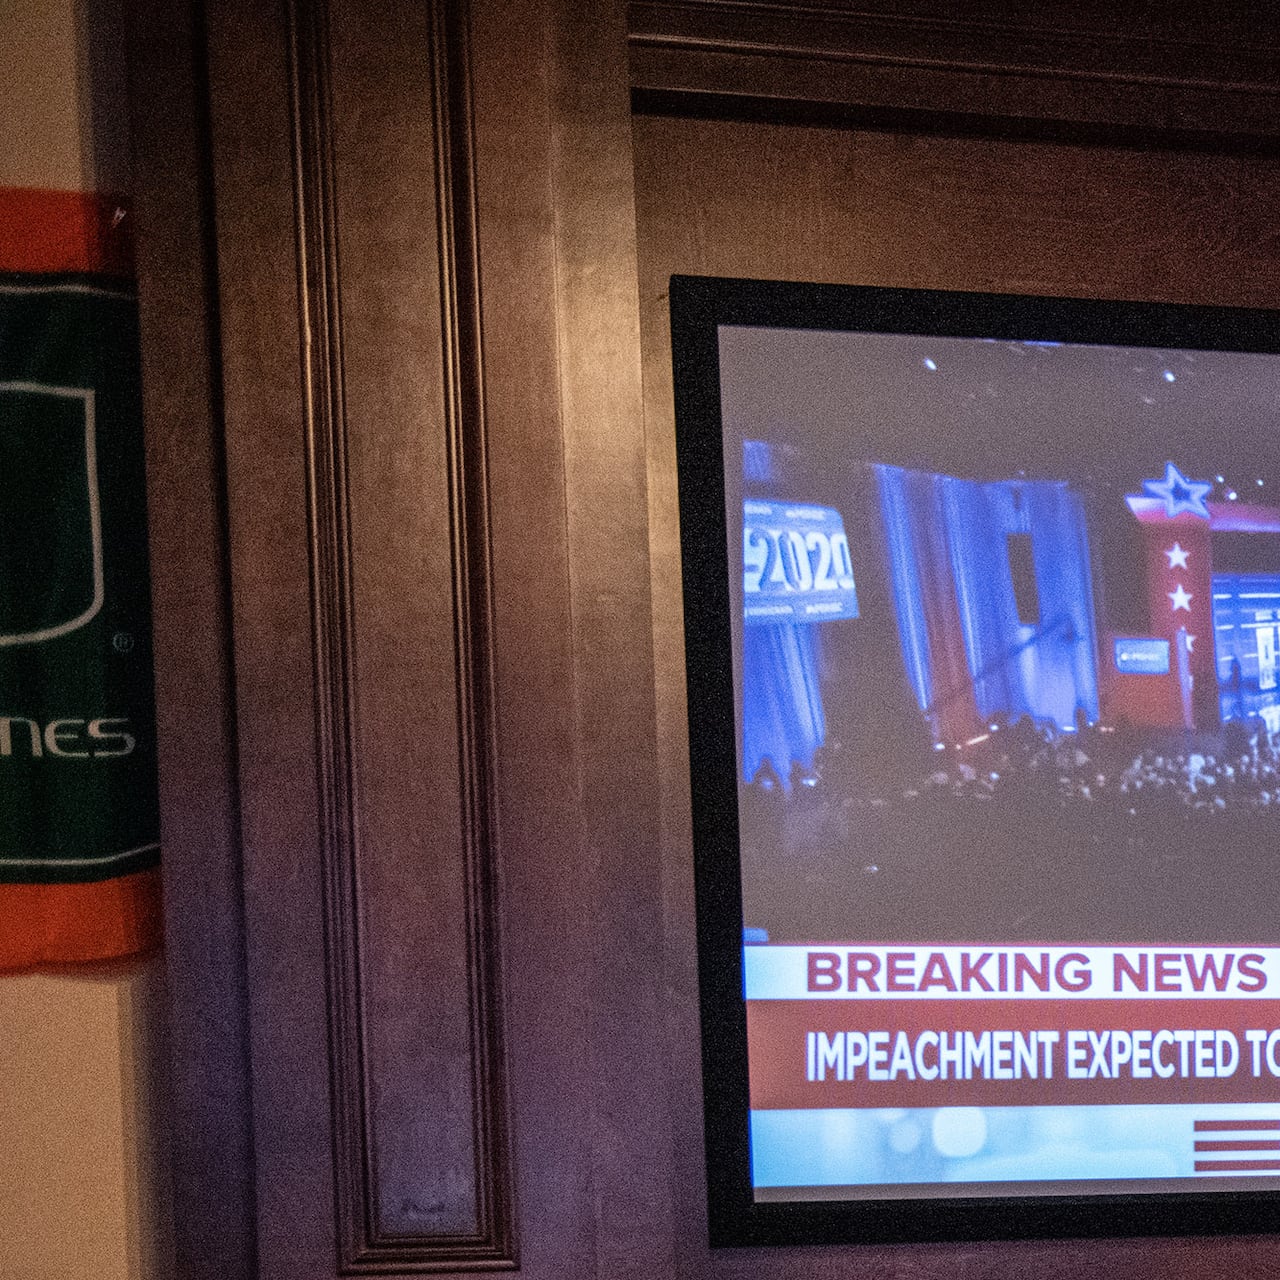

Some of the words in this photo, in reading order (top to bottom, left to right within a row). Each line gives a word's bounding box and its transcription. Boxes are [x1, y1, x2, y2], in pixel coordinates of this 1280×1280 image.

[807, 952, 1092, 992] BREAKING
[1113, 953, 1268, 992] NEWS
[807, 1030, 1059, 1081] IMPEACHMENT
[1066, 1029, 1239, 1079] EXPECTED
